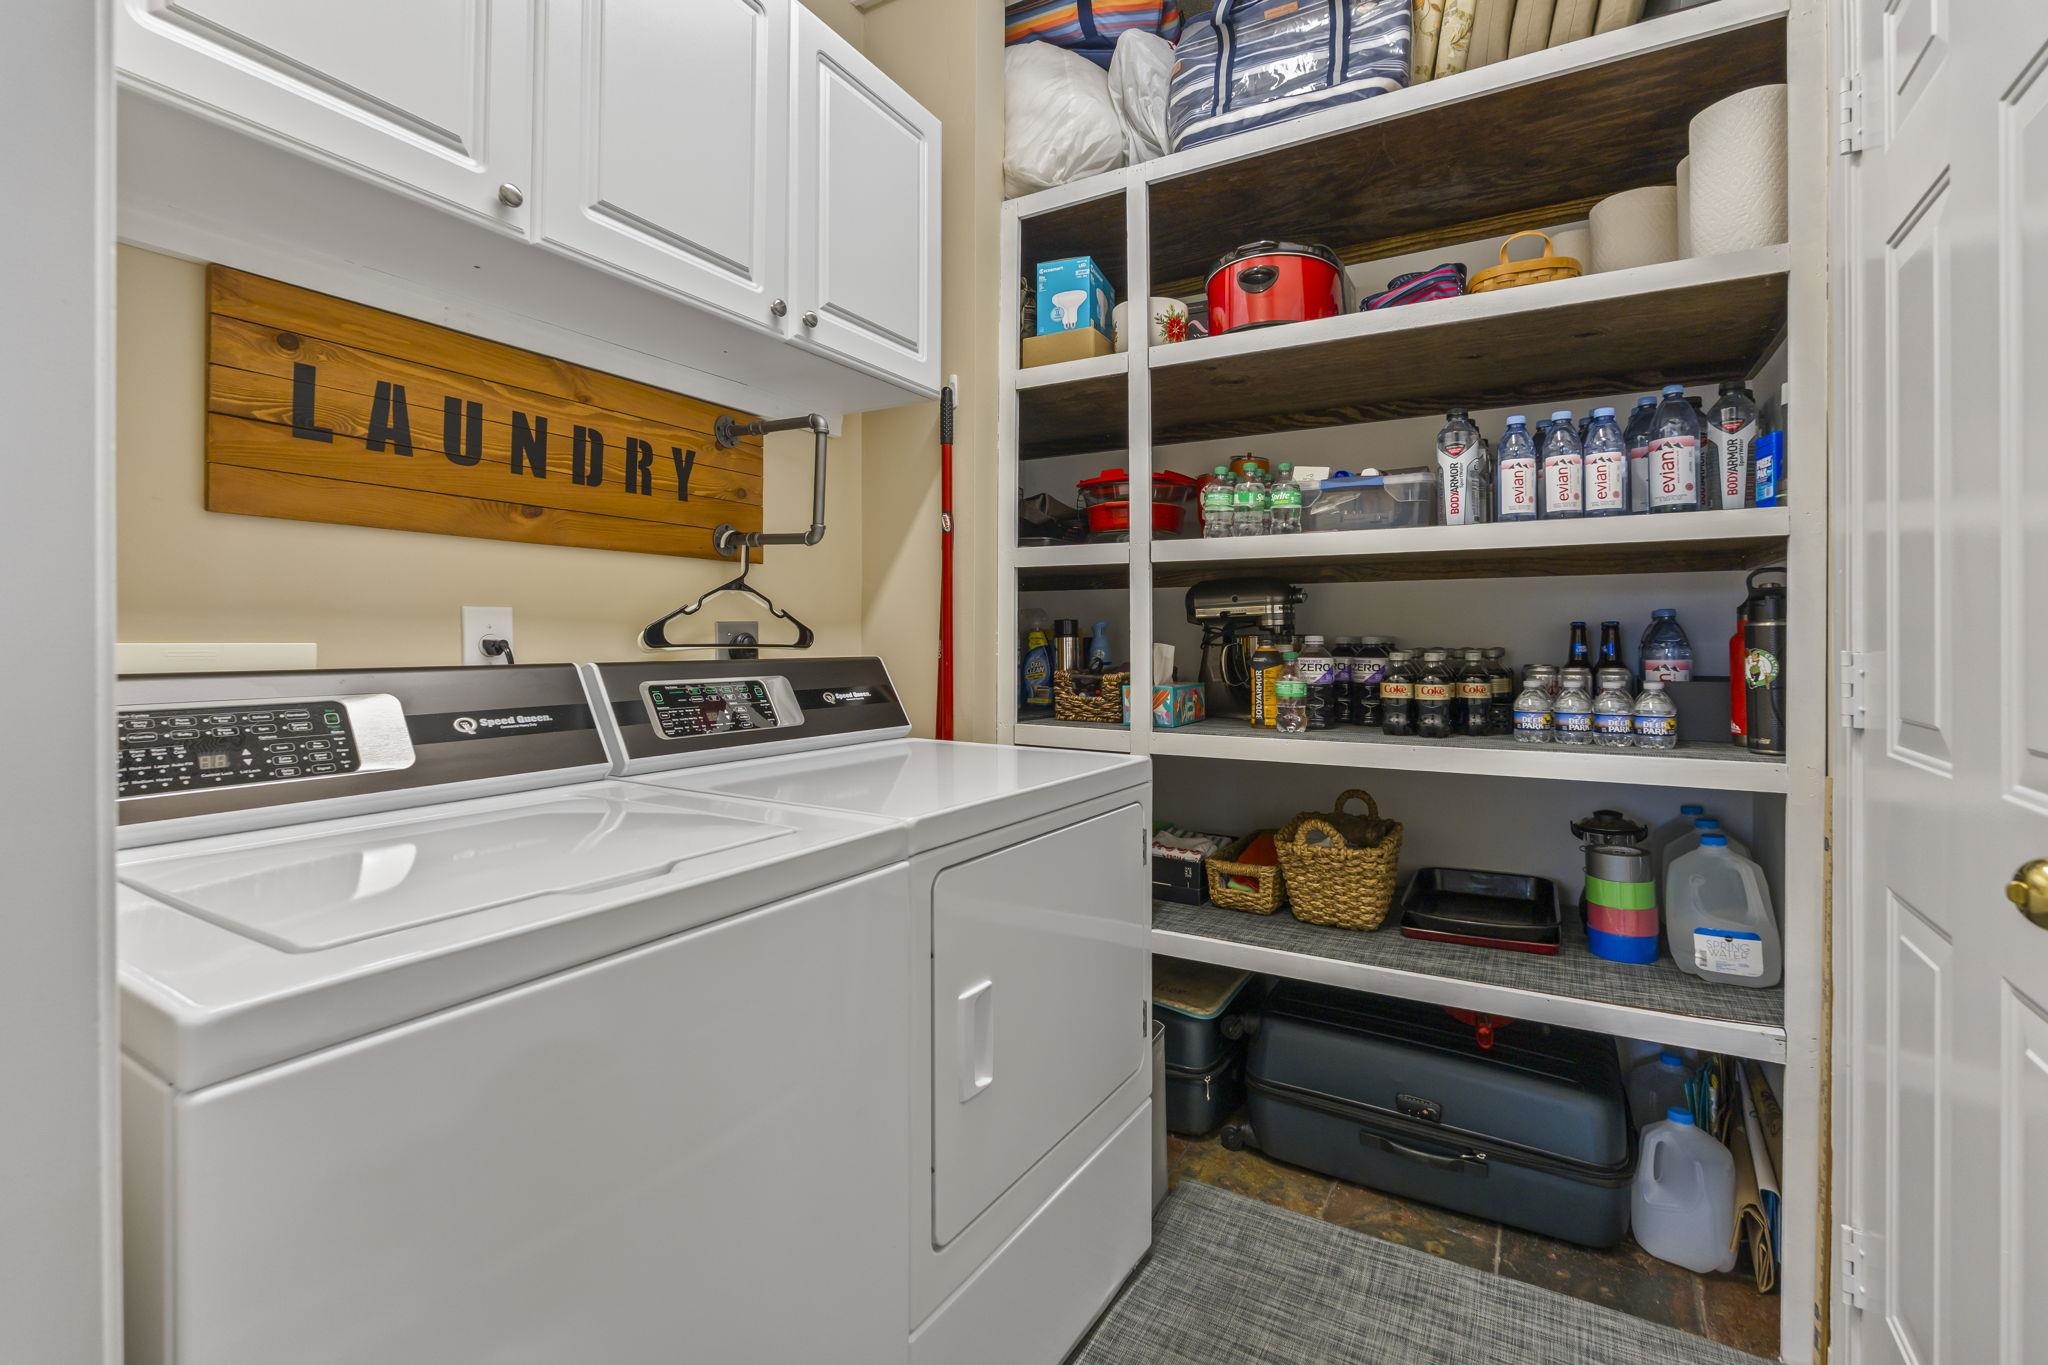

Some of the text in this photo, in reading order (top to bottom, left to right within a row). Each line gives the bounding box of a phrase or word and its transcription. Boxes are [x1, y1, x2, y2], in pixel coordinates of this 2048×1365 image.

[291, 361, 697, 502] LAUNDRY
[1660, 449, 1676, 494] evian
[1727, 438, 1738, 496] BODYARMOR
[1513, 470, 1525, 504] evian
[1557, 466, 1570, 502] evian
[1594, 464, 1608, 500] evian
[1449, 461, 1460, 515] BODYARMOR
[1271, 492, 1290, 502] Sprite
[1300, 663, 1331, 672] ZERO
[1352, 663, 1381, 672] ZERO
[1255, 669, 1263, 720] BODYARMOR
[1384, 684, 1407, 694] Coke
[1421, 686, 1445, 696] Coke
[1462, 684, 1487, 694] Coke
[479, 716, 515, 728] Speed
[1522, 722, 1545, 730] PARK
[1608, 719, 1630, 727] DEER
[1568, 724, 1590, 732] PARK
[1608, 726, 1631, 734] PARK
[1643, 727, 1669, 735] PARK
[1705, 940, 1751, 953] SPRING
[1708, 947, 1749, 960] WATER
